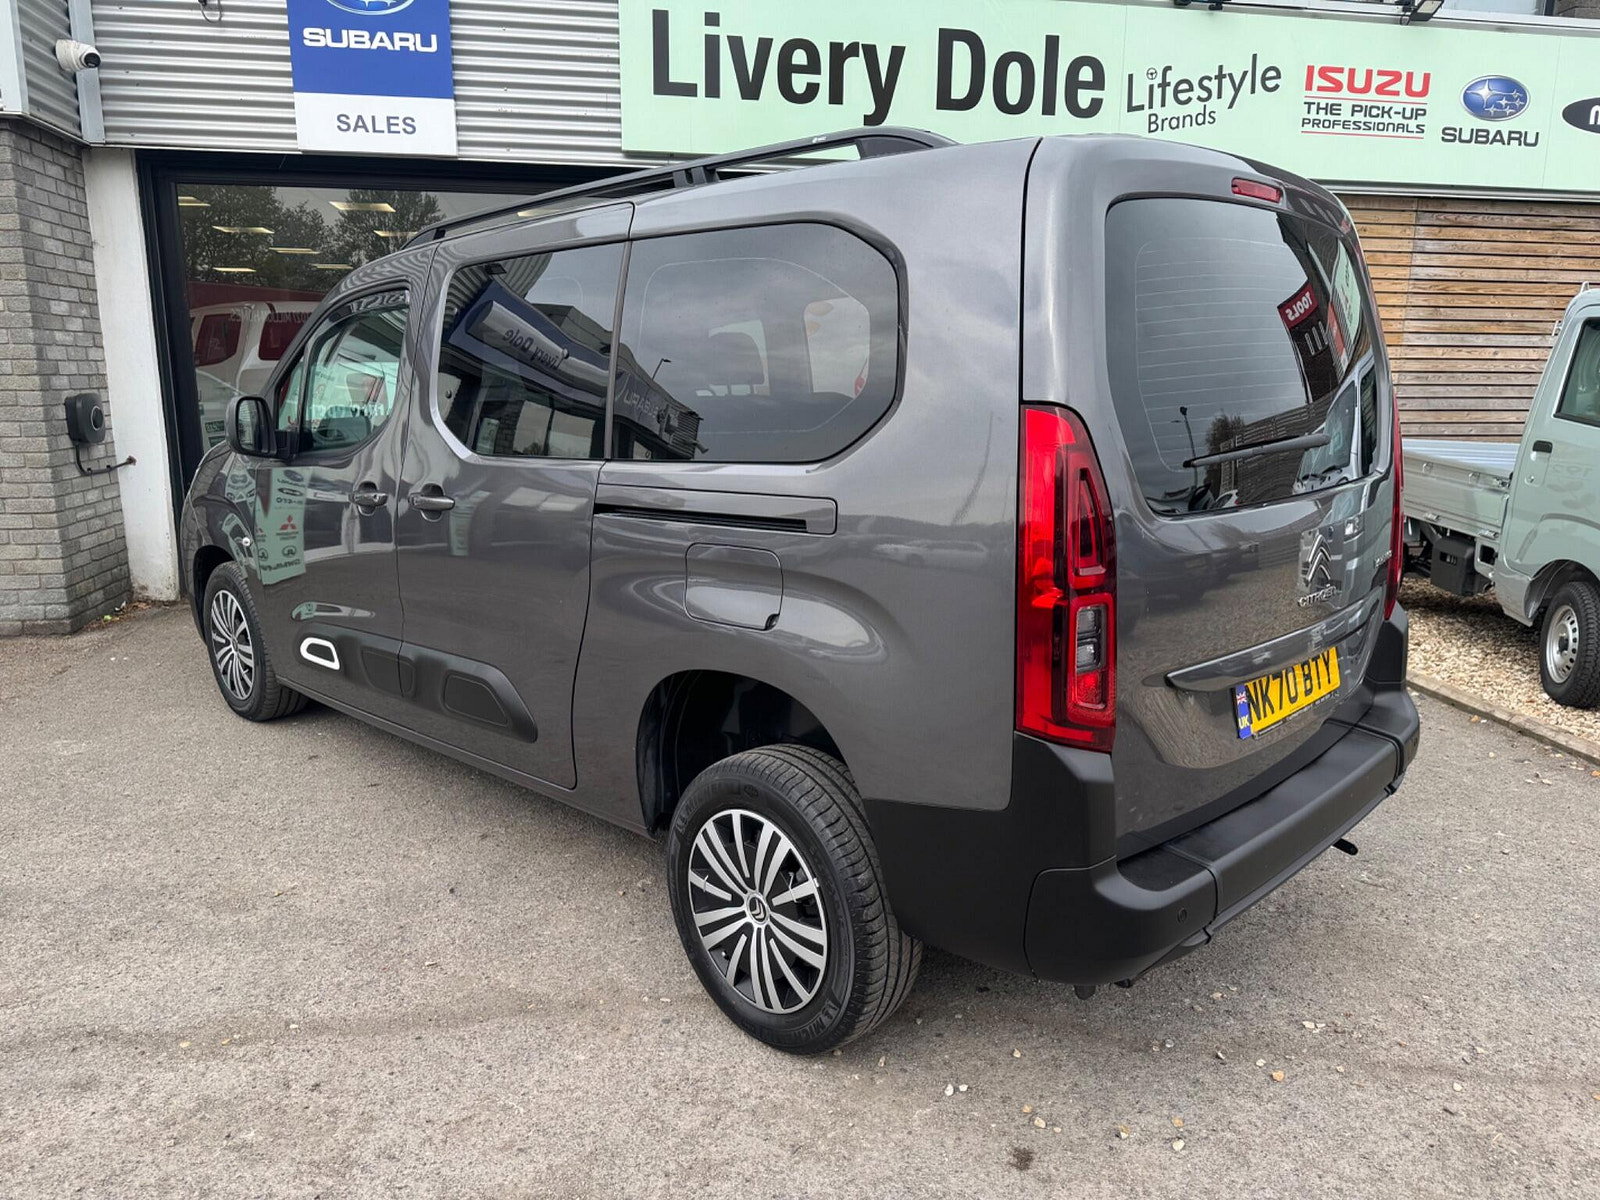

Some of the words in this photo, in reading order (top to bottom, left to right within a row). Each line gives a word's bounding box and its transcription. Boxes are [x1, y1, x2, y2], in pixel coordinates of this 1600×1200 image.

[303, 27, 438, 53] SUBARU
[652, 8, 906, 126] Livery
[935, 27, 1106, 119] Dole
[1126, 53, 1282, 113] Lifestyle
[1304, 65, 1431, 98] ISUZU
[336, 113, 417, 135] SALES
[1147, 104, 1217, 133] Brands
[1303, 101, 1342, 116] THE
[1350, 104, 1427, 121] PICK-UP
[1301, 117, 1426, 134] PROFESSIONALS
[1440, 126, 1539, 147] SUBARU
[1245, 666, 1299, 724] NK70
[1301, 650, 1333, 698] BTY
